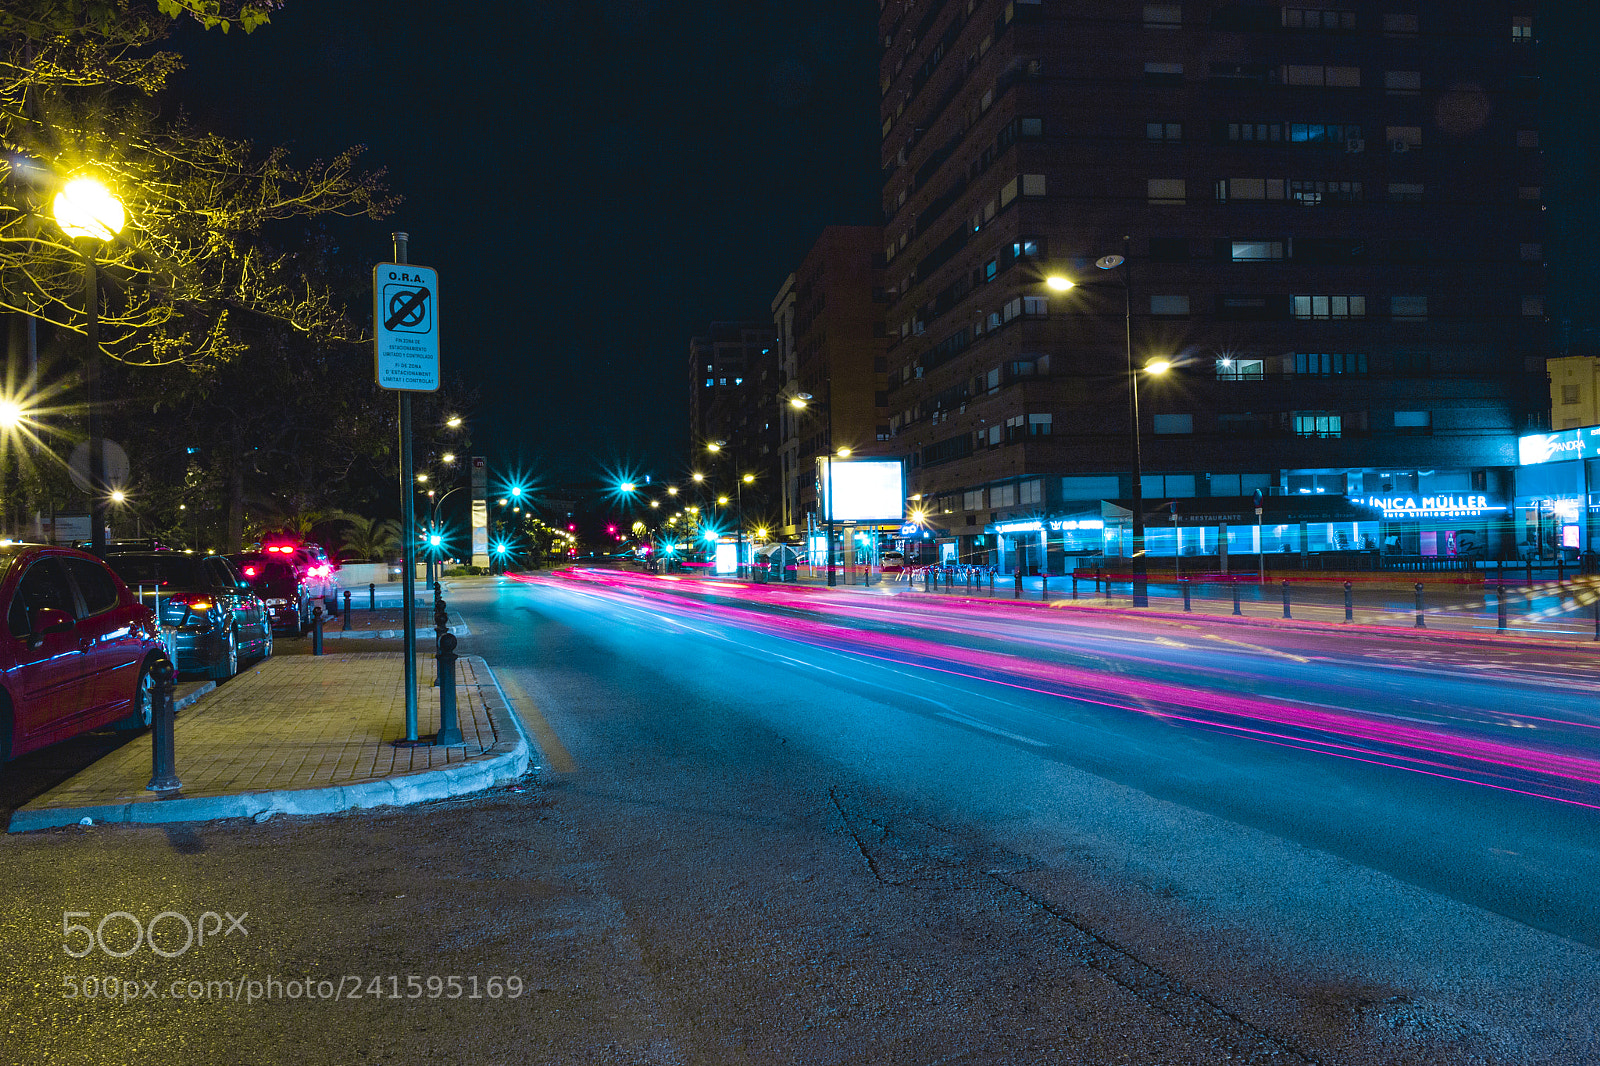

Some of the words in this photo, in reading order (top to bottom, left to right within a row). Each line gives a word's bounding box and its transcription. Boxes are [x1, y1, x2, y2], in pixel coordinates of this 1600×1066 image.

[388, 271, 425, 283] O.R.A.
[389, 344, 427, 352] ESTACIONAMIENTO
[1422, 495, 1488, 509] MÜLLER
